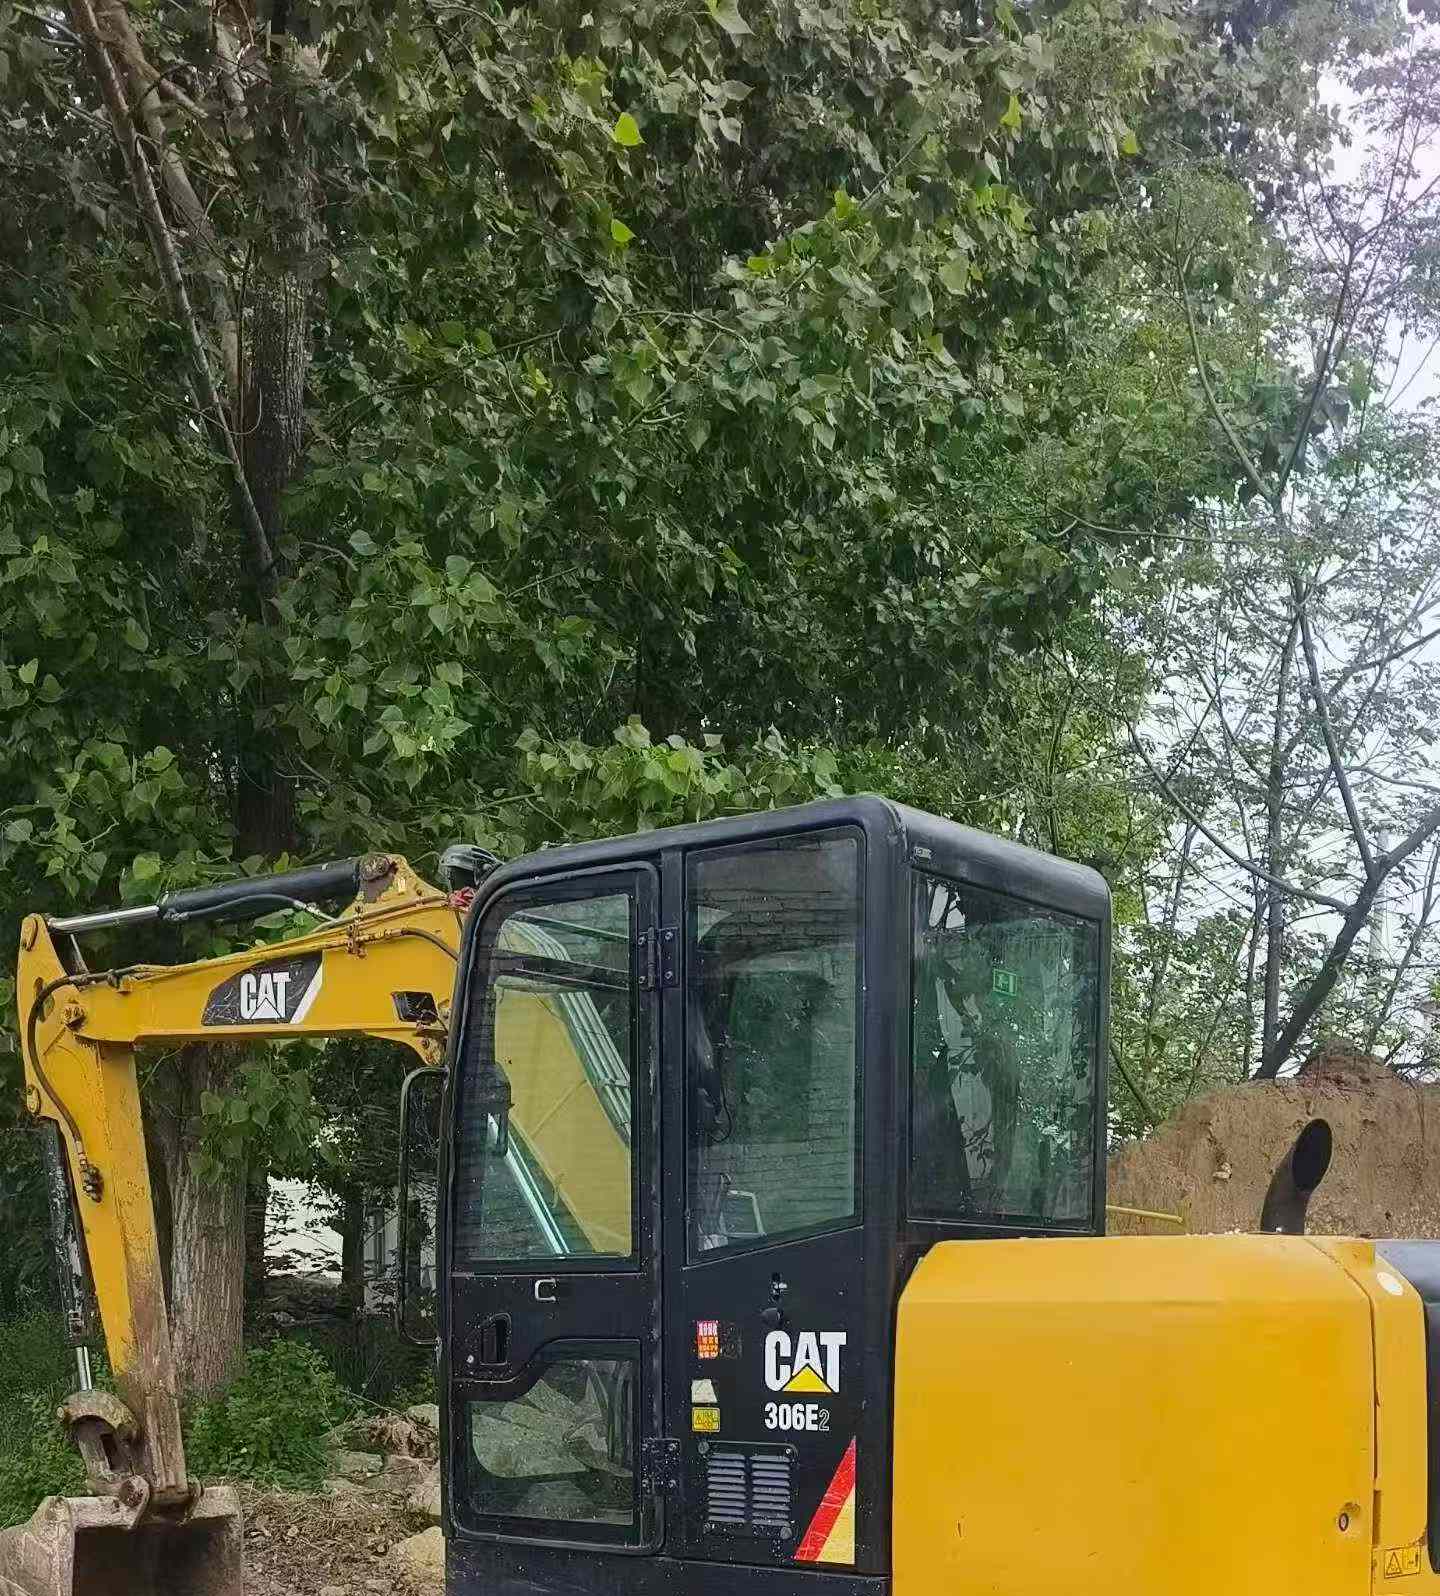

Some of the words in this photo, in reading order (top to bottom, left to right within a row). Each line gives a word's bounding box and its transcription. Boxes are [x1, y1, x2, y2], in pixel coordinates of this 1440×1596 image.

[240, 971, 291, 1019] CAT
[764, 1330, 847, 1393] CAT
[764, 1402, 830, 1431] 306E2
